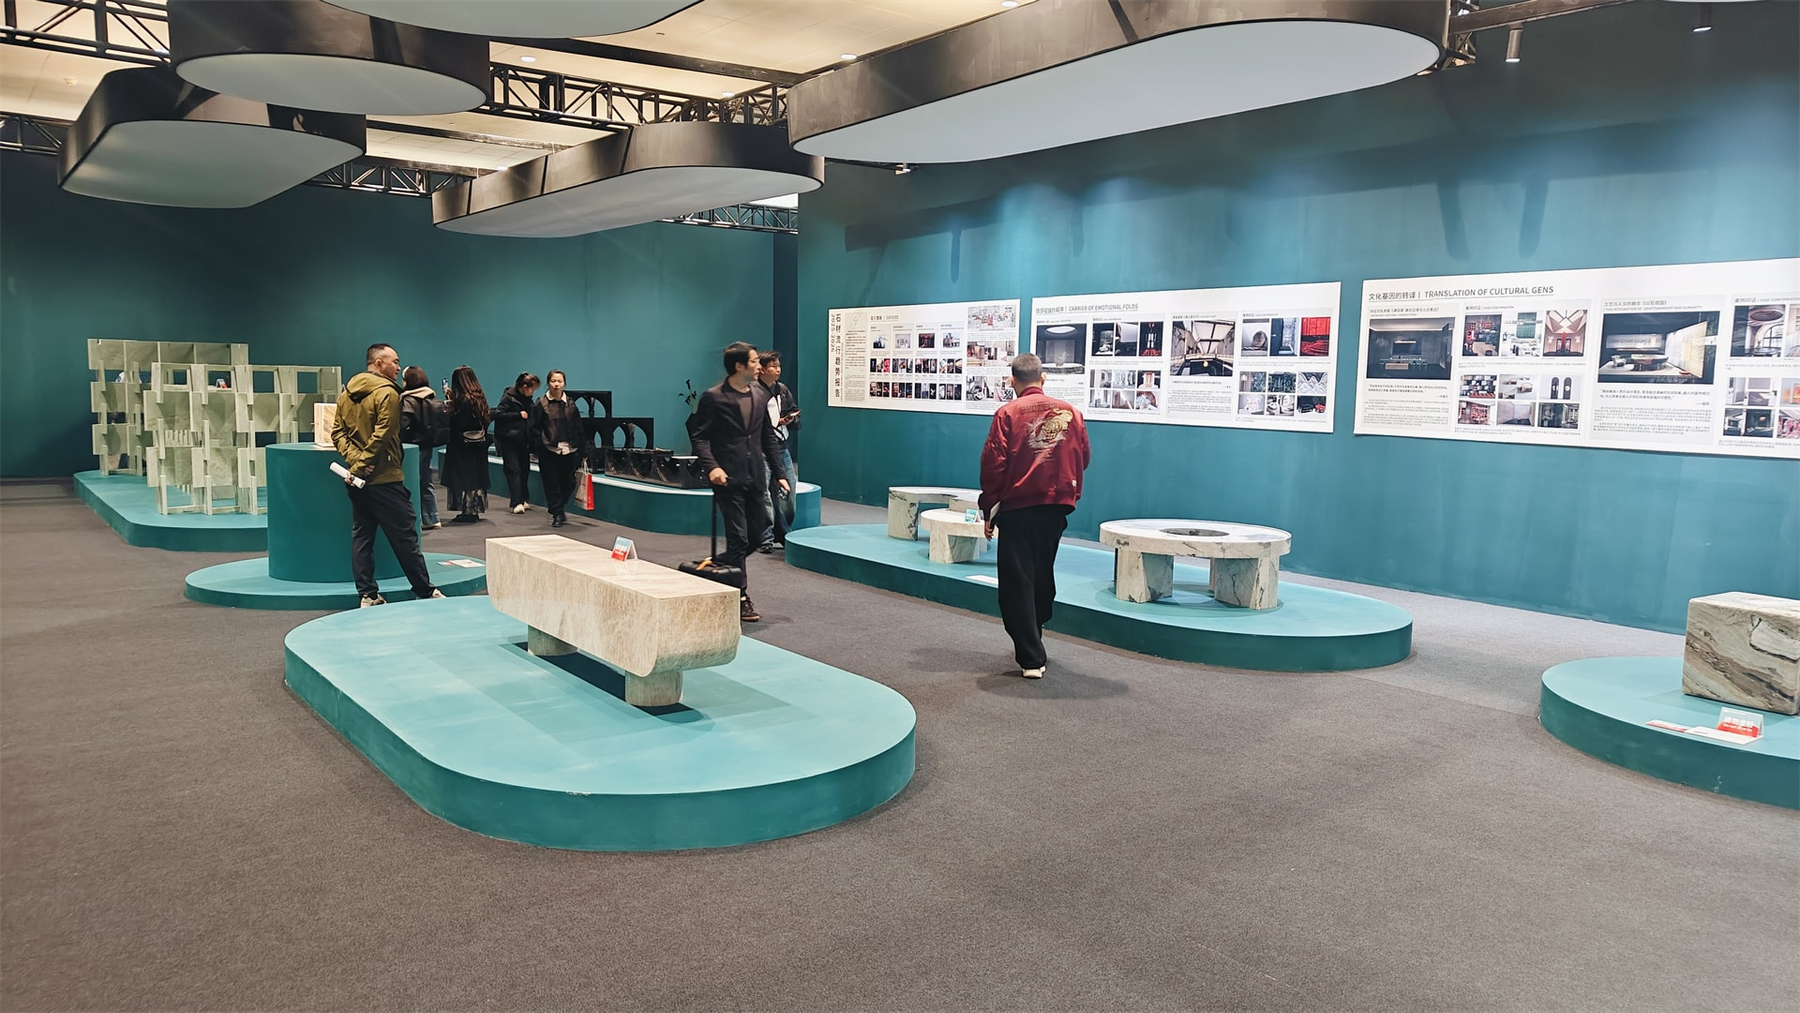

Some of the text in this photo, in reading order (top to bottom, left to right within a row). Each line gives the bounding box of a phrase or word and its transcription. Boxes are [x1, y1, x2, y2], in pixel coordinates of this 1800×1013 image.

[1425, 289, 1476, 299] TRANSLATION
[1477, 288, 1488, 296] OF
[1489, 287, 1529, 296] CULTURAL
[1531, 286, 1554, 294] GENS
